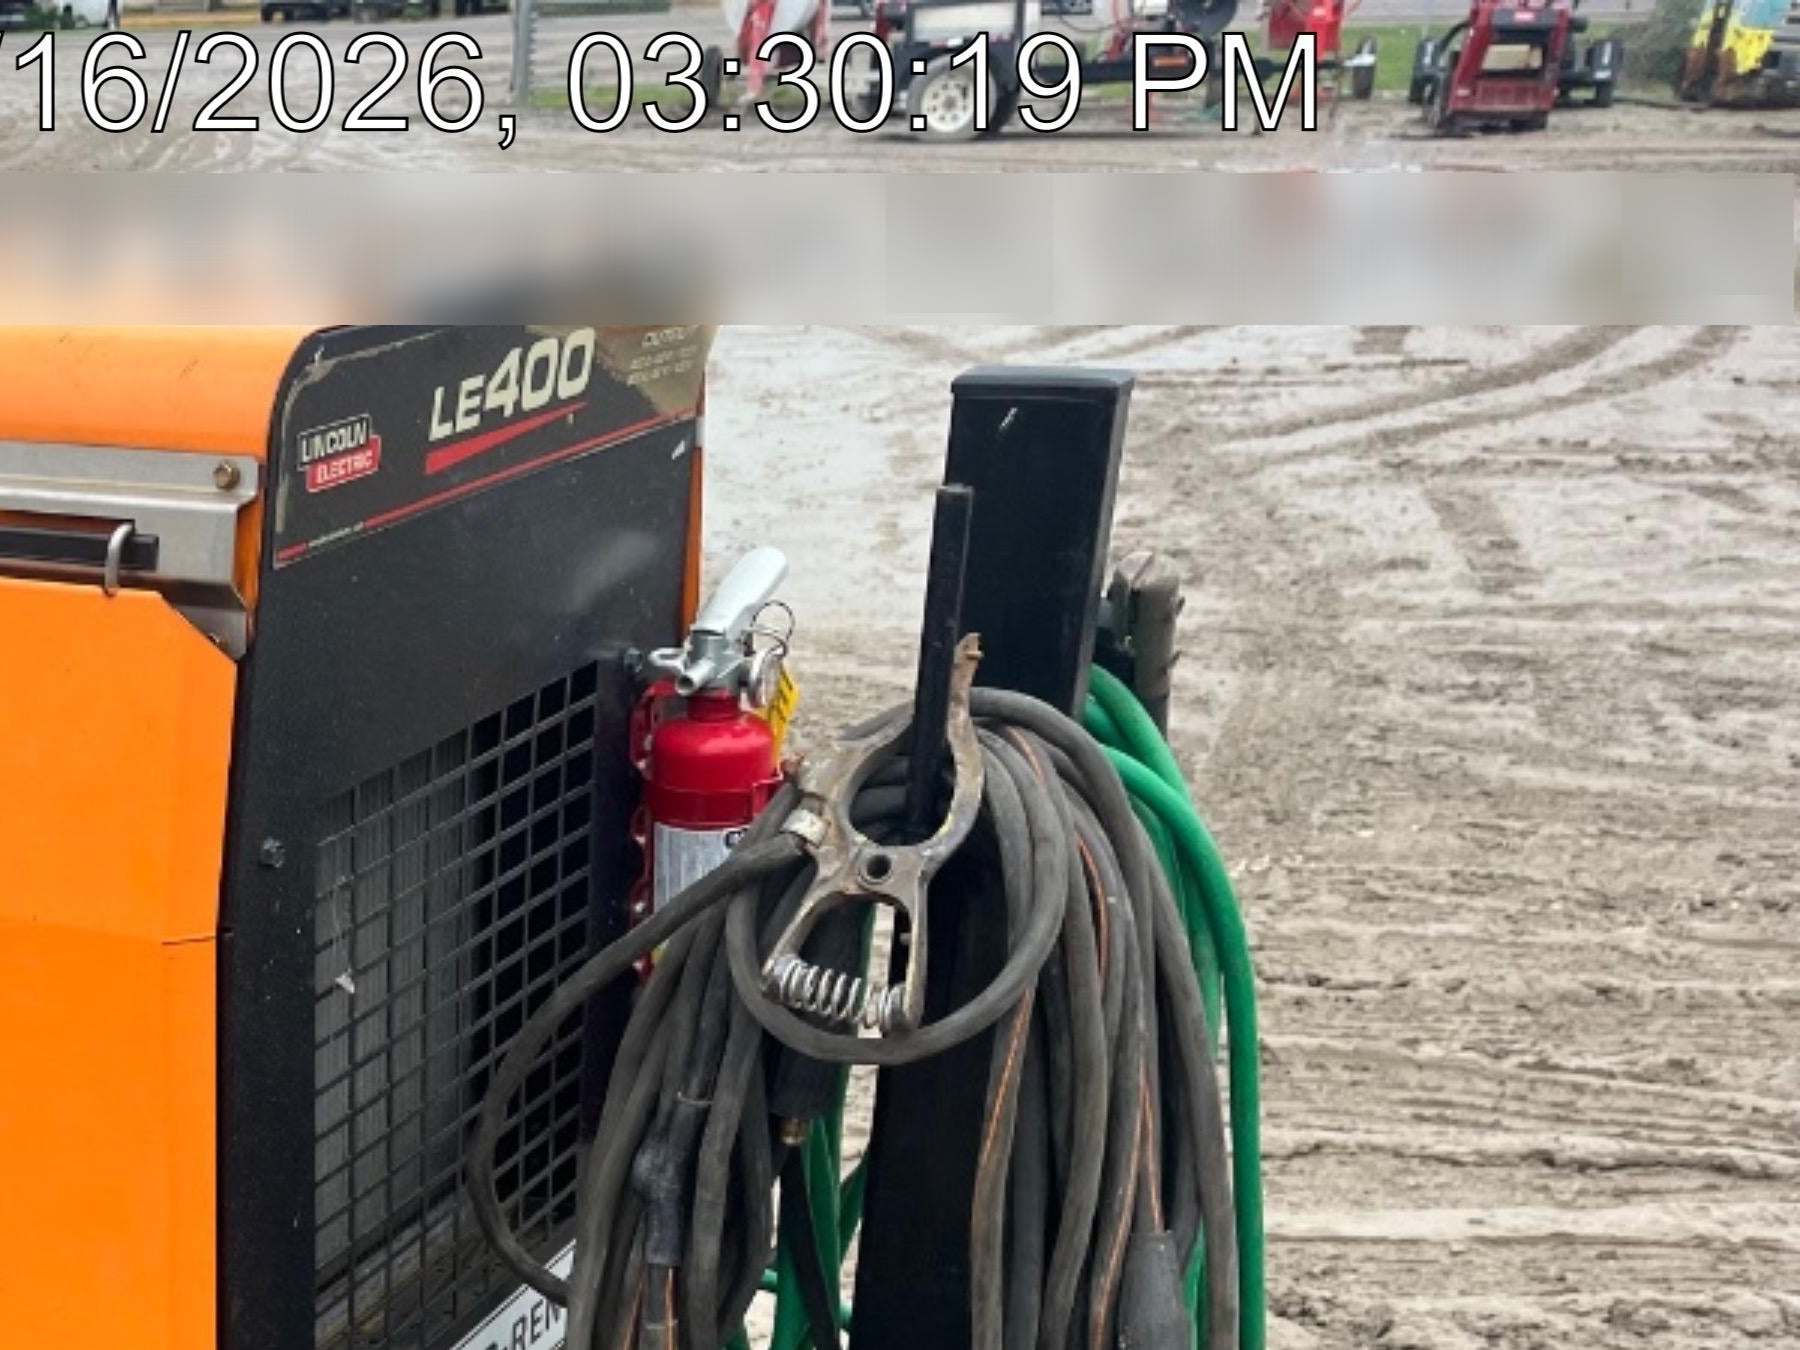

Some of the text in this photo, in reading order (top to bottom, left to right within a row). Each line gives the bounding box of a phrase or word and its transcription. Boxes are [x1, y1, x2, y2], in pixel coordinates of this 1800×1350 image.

[428, 327, 596, 441] LE400
[301, 419, 369, 463] LINCOLN
[316, 448, 374, 484] ELECTRIC
